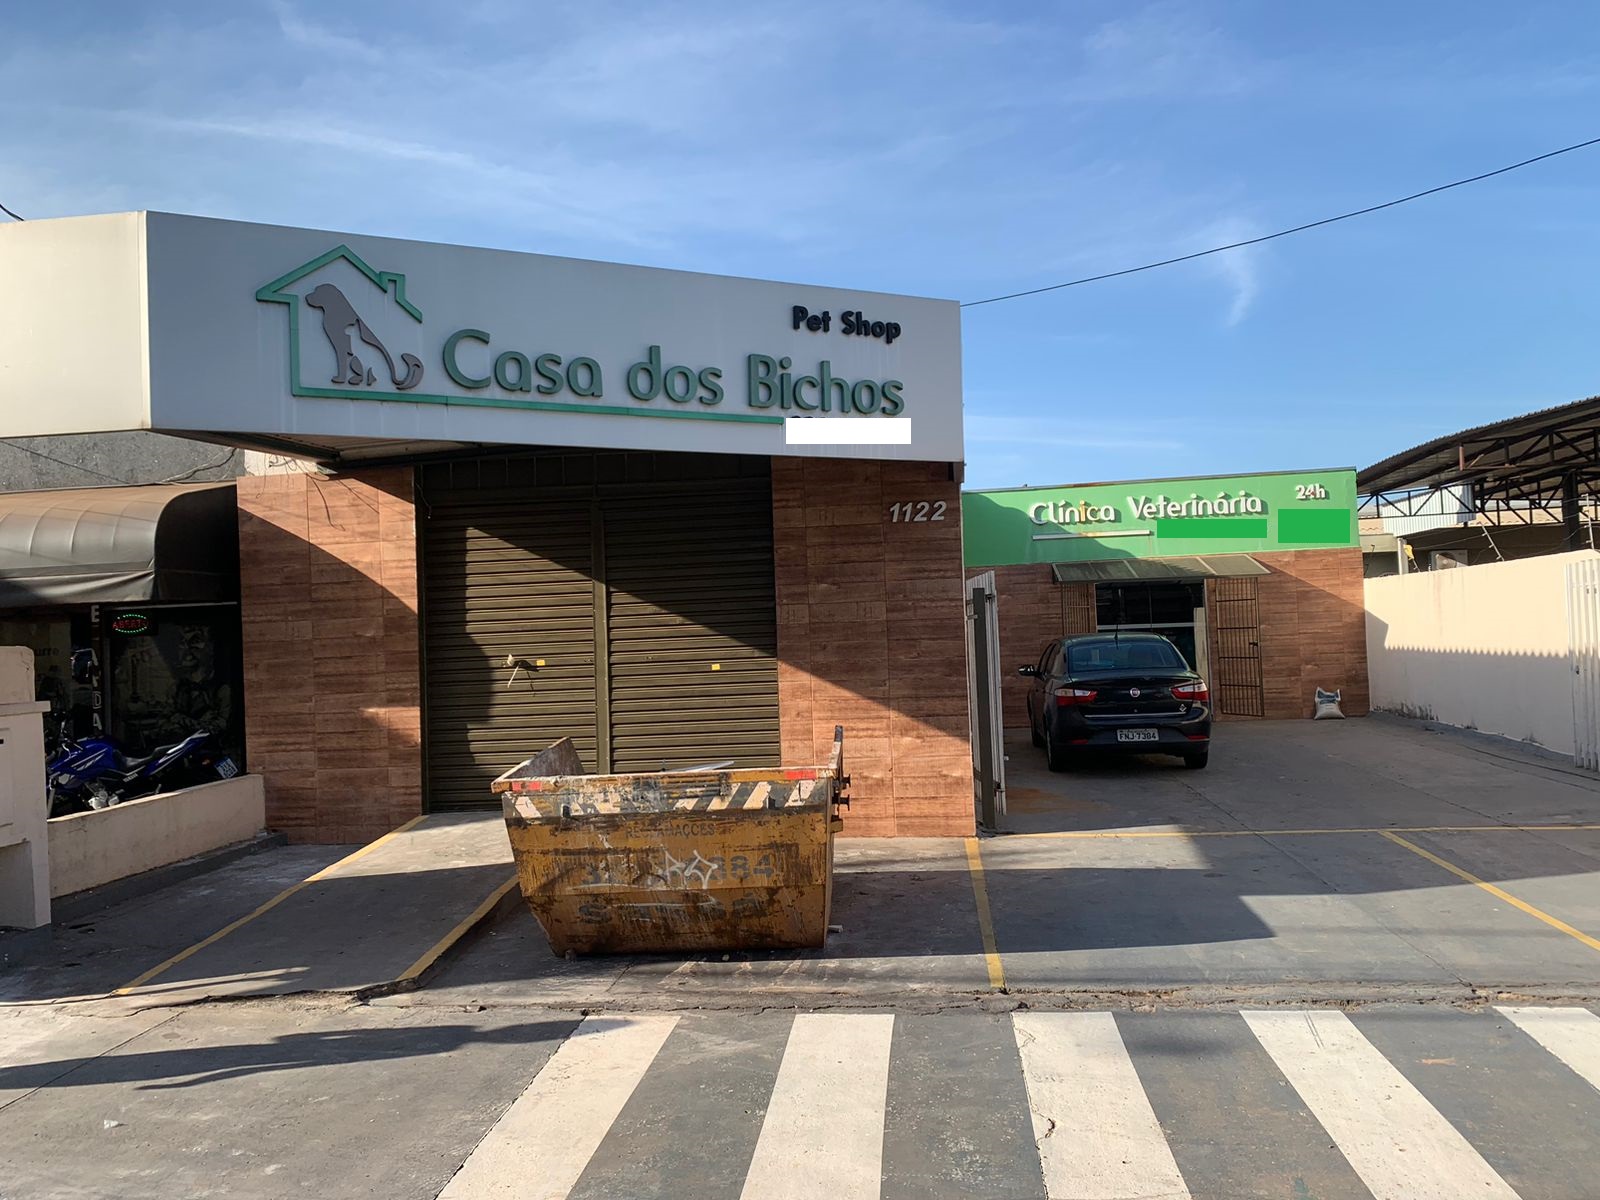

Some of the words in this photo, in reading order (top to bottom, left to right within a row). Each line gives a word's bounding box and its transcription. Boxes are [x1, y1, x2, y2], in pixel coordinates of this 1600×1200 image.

[792, 305, 831, 332] Pet
[841, 310, 901, 344] Shop
[442, 328, 603, 397] Casa
[626, 345, 725, 405] dos
[748, 353, 905, 416] Bichos
[1029, 499, 1116, 525] Clínica
[1126, 489, 1263, 519] Veterinária
[1295, 484, 1326, 500] 24h
[889, 501, 948, 522] 1122
